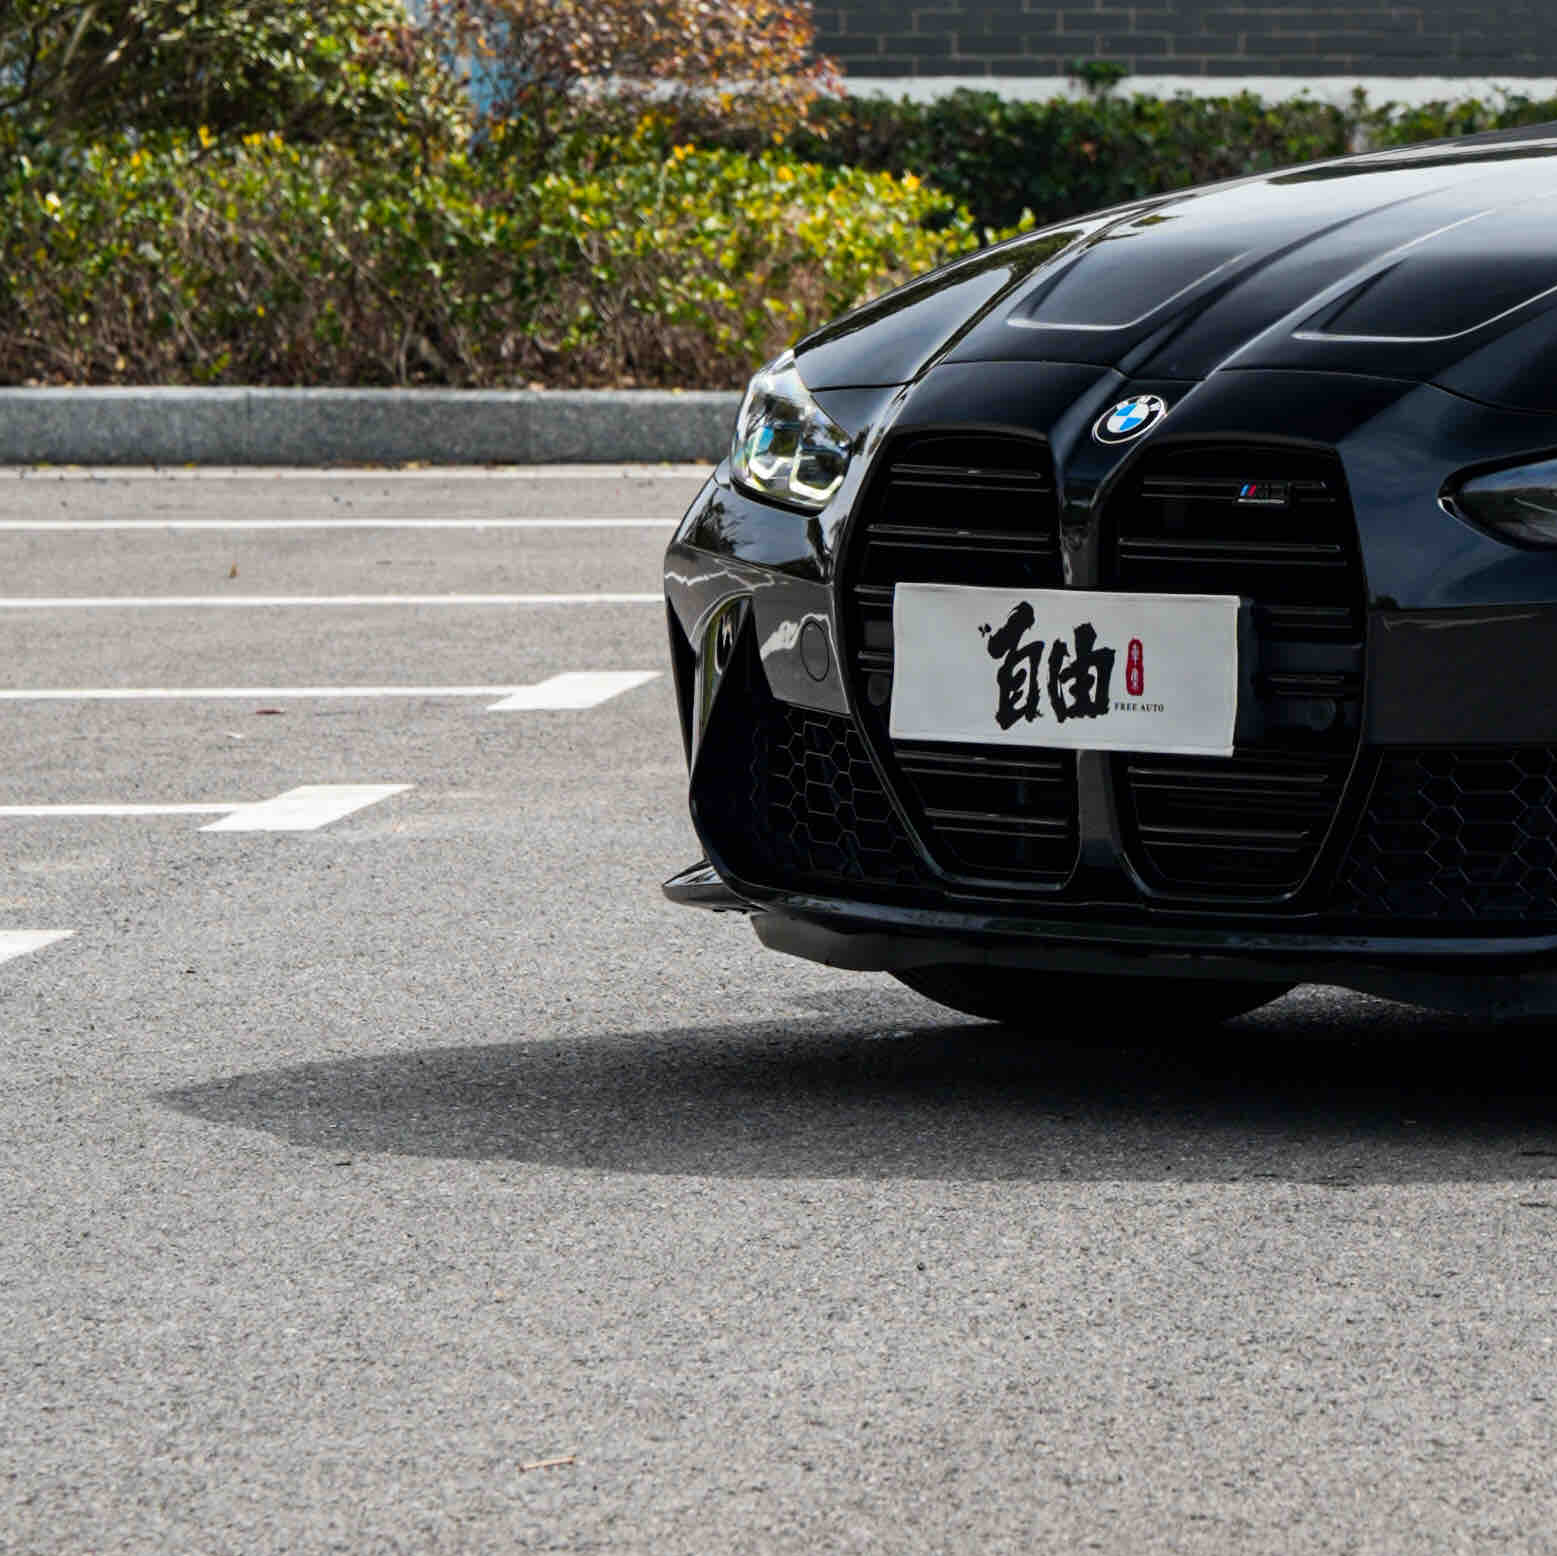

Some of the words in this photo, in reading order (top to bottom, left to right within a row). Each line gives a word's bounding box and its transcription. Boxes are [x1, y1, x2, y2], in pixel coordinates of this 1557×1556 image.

[978, 601, 1116, 731] 自由
[1114, 702, 1137, 713] FREE
[1141, 703, 1165, 713] AUTO
